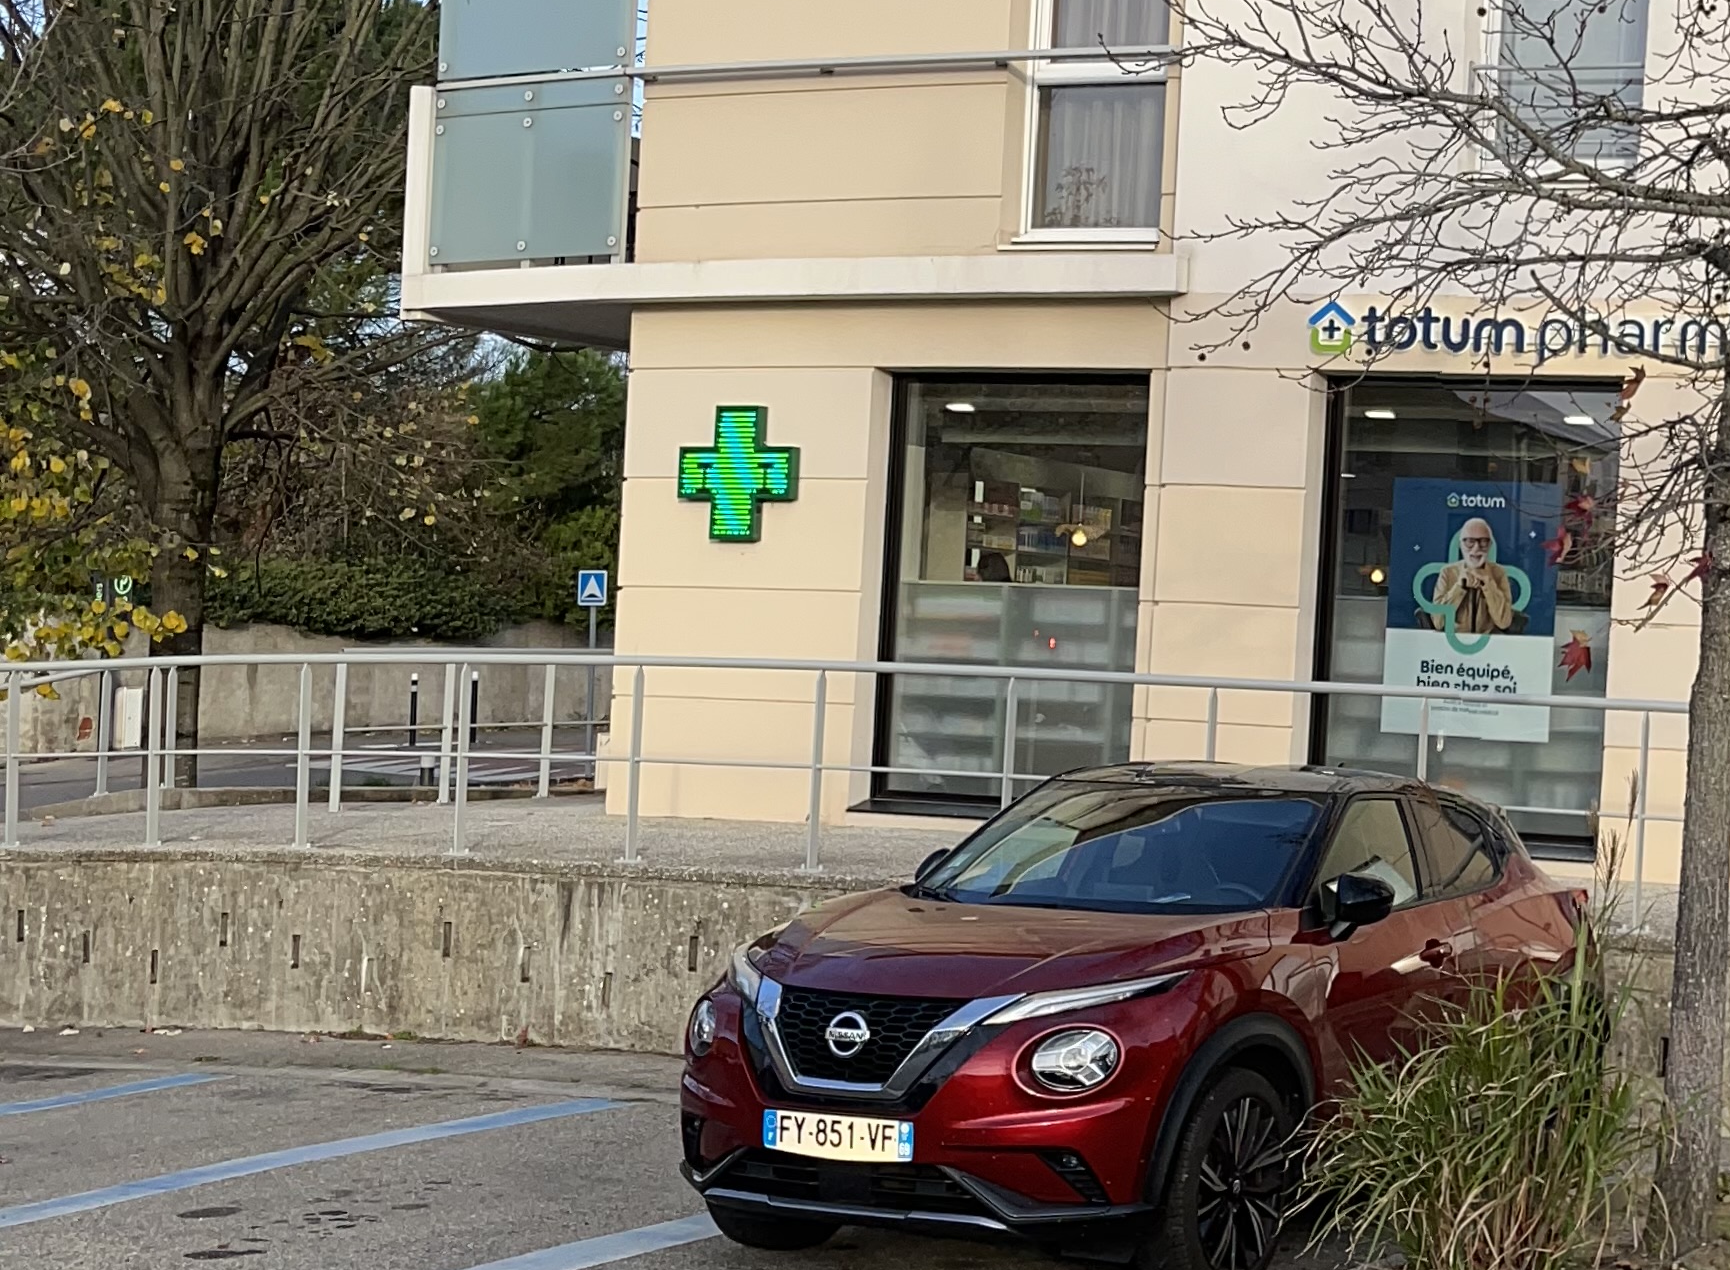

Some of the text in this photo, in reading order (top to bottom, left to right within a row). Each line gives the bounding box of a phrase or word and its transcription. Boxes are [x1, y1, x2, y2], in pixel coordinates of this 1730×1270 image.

[1362, 306, 1526, 353] totum
[1461, 493, 1506, 508] totum
[1420, 659, 1515, 682] Bien équipé,
[828, 1029, 864, 1040] NISSAN
[779, 1115, 896, 1153] FY-851-VF
